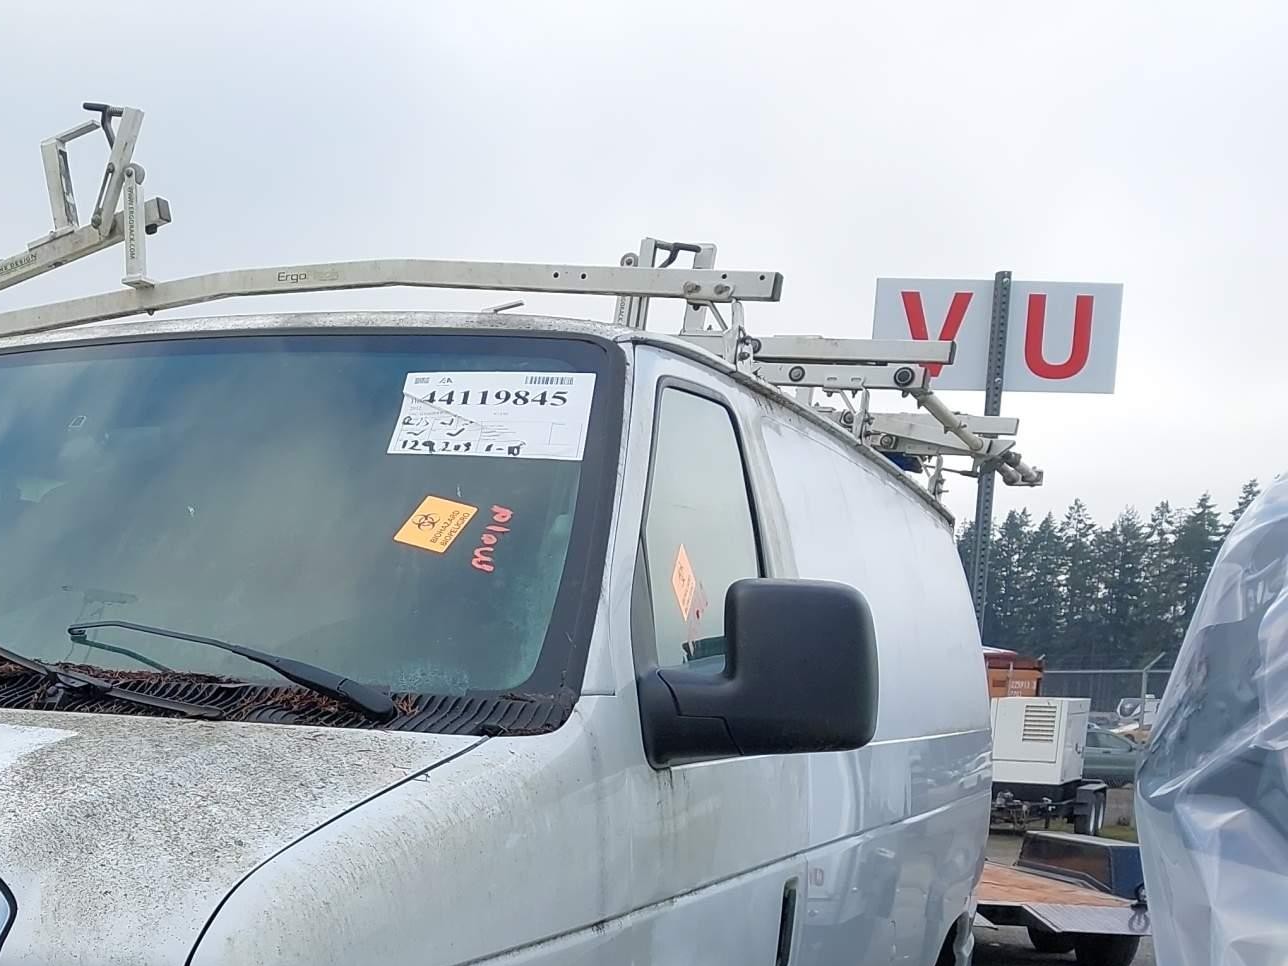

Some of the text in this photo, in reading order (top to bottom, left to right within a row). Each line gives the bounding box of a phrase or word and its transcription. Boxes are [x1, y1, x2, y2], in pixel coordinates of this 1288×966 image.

[277, 271, 307, 284] Ergo
[901, 291, 1094, 380] V U
[423, 389, 569, 406] 44119845
[429, 509, 461, 545] BIOHAZARD
[439, 511, 471, 547] BIOPELIGRO
